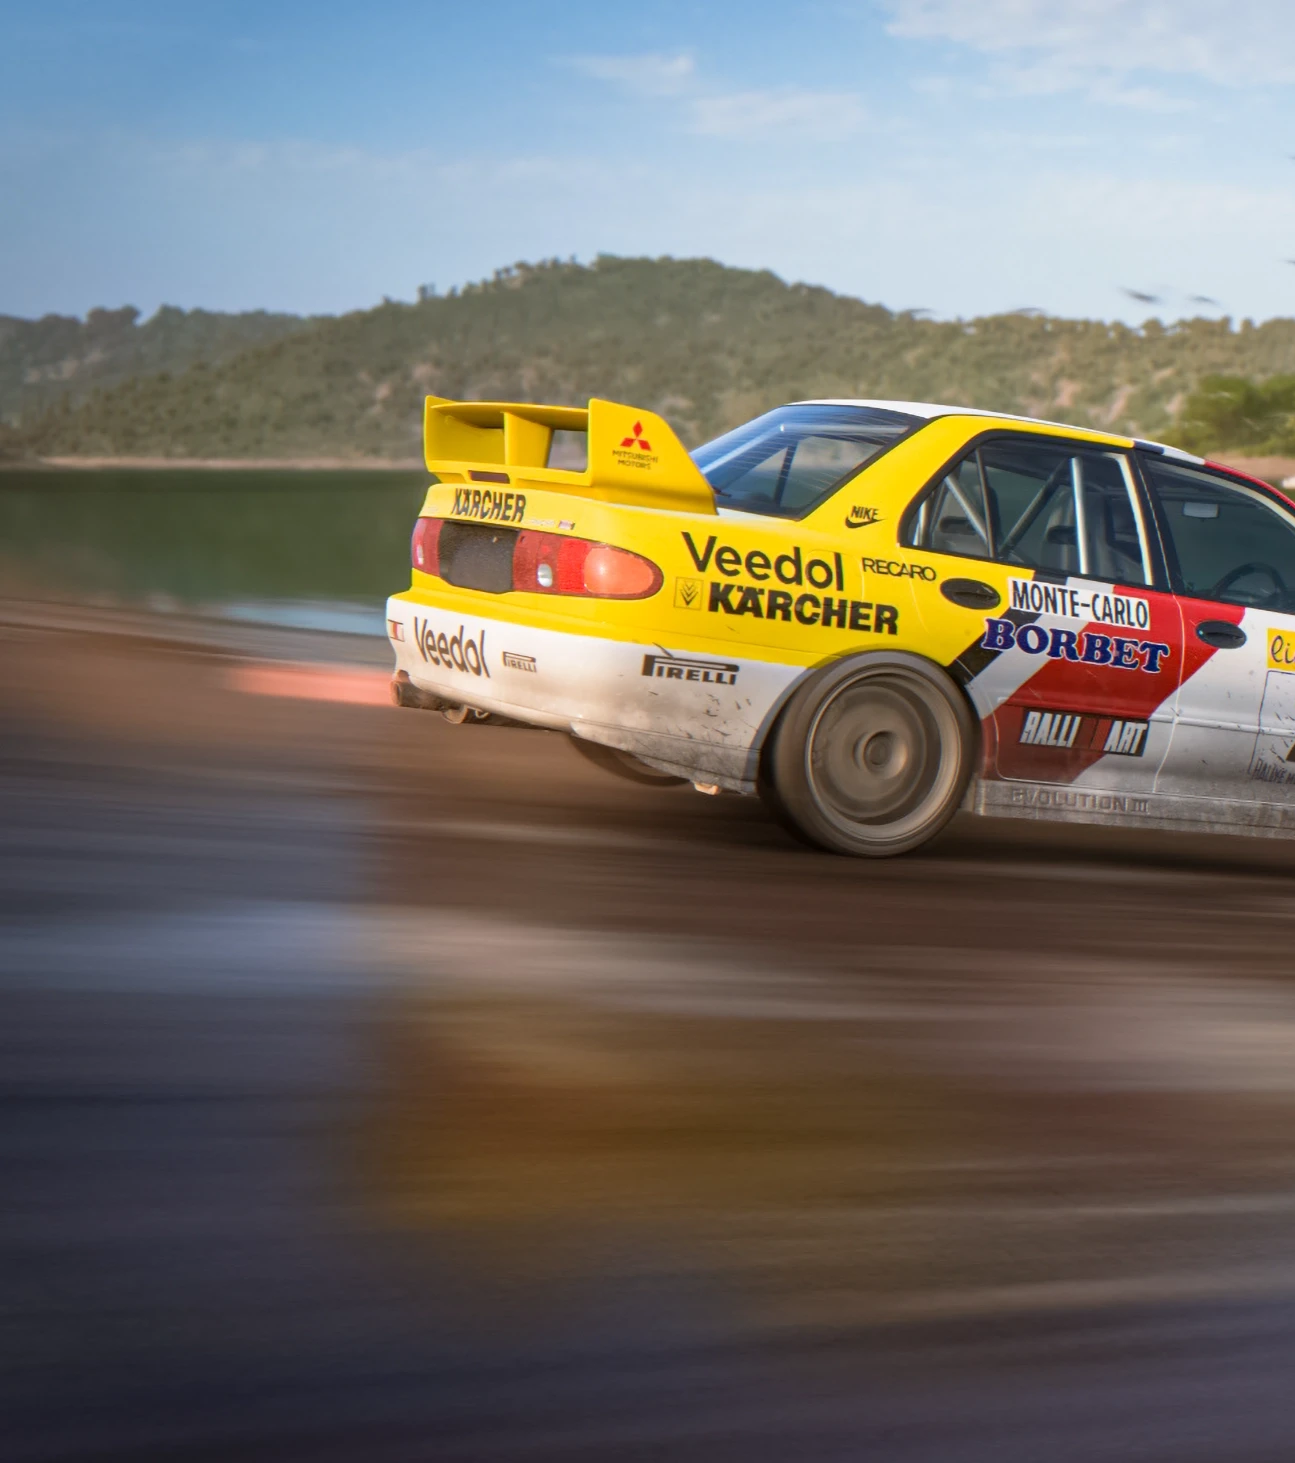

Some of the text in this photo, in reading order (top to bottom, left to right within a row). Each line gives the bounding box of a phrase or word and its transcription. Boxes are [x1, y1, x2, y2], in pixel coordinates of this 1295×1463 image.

[450, 487, 527, 522] KÄRCHER
[850, 505, 880, 521] NIKE
[681, 531, 844, 591] Veedol
[862, 557, 937, 582] RECARO
[708, 582, 899, 635] KÄRCHER
[1011, 580, 1148, 628] MONTE-CARLO
[414, 616, 490, 678] Veedol
[503, 651, 538, 673] PIRELLI
[982, 618, 1170, 673] BORBET
[642, 654, 740, 685] PIRELLI
[1020, 711, 1148, 754] RALLI ART
